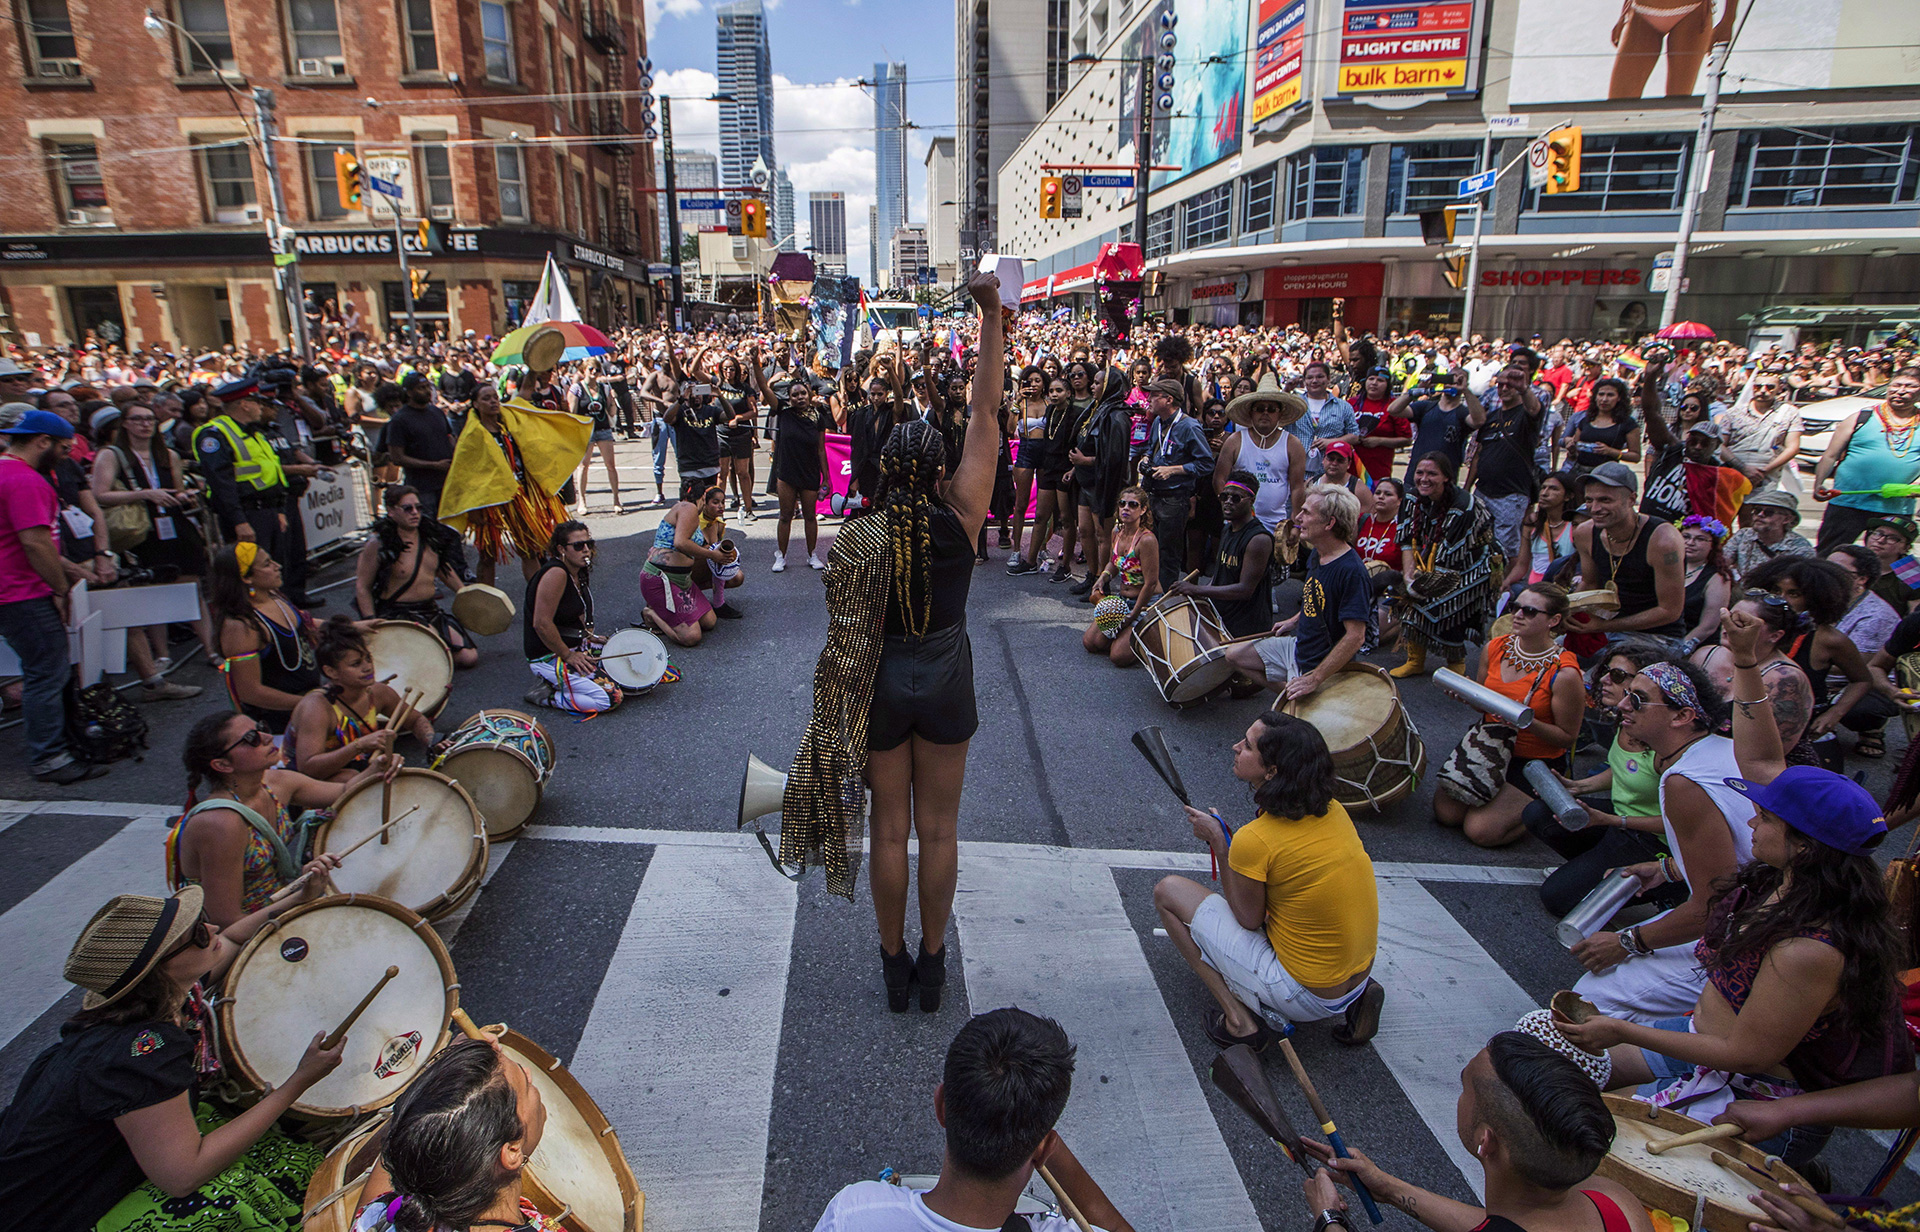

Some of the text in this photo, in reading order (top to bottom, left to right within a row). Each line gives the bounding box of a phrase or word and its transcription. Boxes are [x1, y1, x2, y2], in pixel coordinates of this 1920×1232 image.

[1259, 26, 1276, 44] OPEN
[1282, 3, 1305, 27] HOURS
[1346, 37, 1461, 57] FLIGHT CENTRE
[1256, 56, 1300, 92] FLIGHT CENTRE
[1346, 66, 1441, 87] bulk barn
[1255, 87, 1292, 118] bulk barn
[1211, 90, 1240, 149] H&M
[1490, 116, 1521, 126] mega
[1090, 176, 1121, 186] Carlton
[1466, 177, 1485, 193] Yonge
[685, 200, 714, 210] College
[270, 234, 393, 254] SARBUCKS
[573, 244, 625, 272] STARBUCKS COFFEE
[1283, 272, 1349, 283] shoppersdrugmart.ca
[1283, 281, 1348, 291] OPEN 24 HOURS
[1480, 268, 1643, 287] SHOPPERS
[1191, 282, 1236, 300] SHOPPERS
[307, 485, 345, 511] Media
[315, 508, 344, 530] Only
